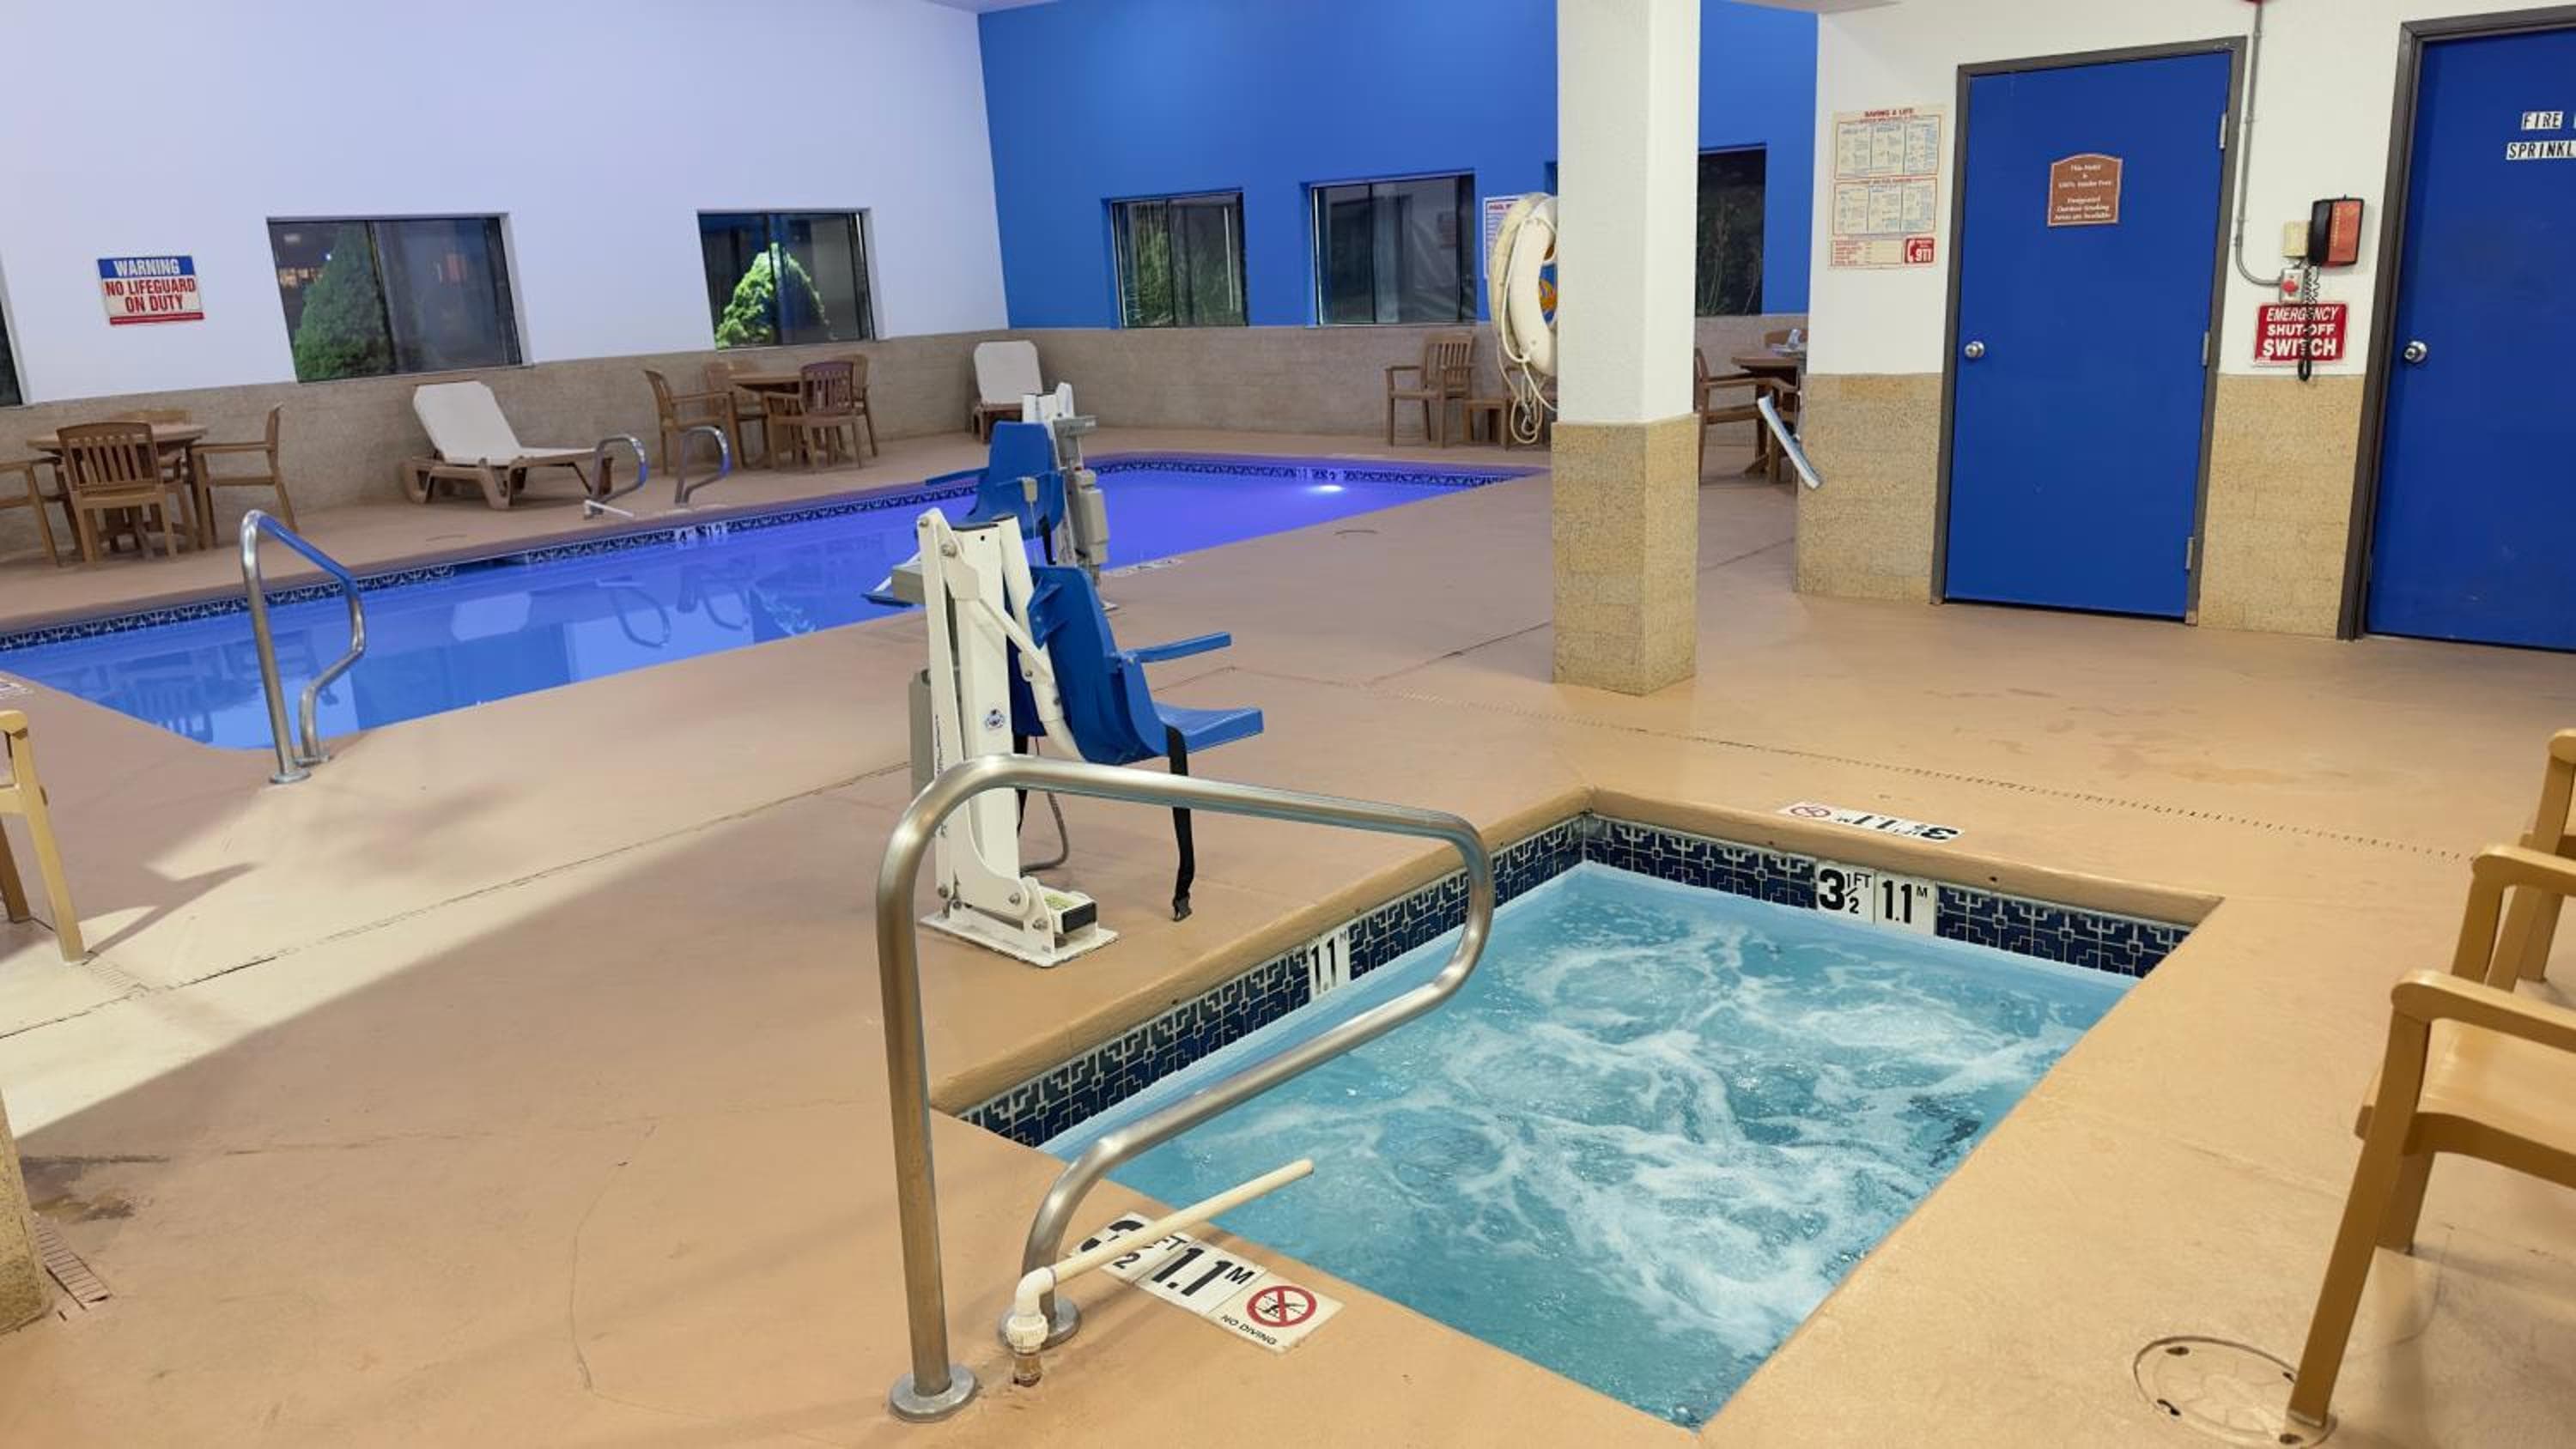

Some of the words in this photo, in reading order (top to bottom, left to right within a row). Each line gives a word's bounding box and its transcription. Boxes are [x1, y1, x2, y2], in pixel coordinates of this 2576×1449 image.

[2524, 112, 2561, 128] FIRE
[2508, 142, 2574, 159] SPRINKL
[1916, 247, 1932, 262] 911
[112, 258, 181, 276] WARNING
[105, 281, 125, 296] NO
[127, 278, 196, 295] LIFEGUARD
[125, 296, 145, 312] ON
[149, 294, 183, 312] DUTY
[1920, 827, 1959, 840] 3
[1882, 880, 1912, 925] 1.1
[1917, 885, 1929, 898] M
[1151, 1247, 1233, 1297] 1.1
[1224, 1265, 1256, 1286] M
[1221, 1314, 1239, 1326] NO
[1238, 1323, 1279, 1345] DIVING
